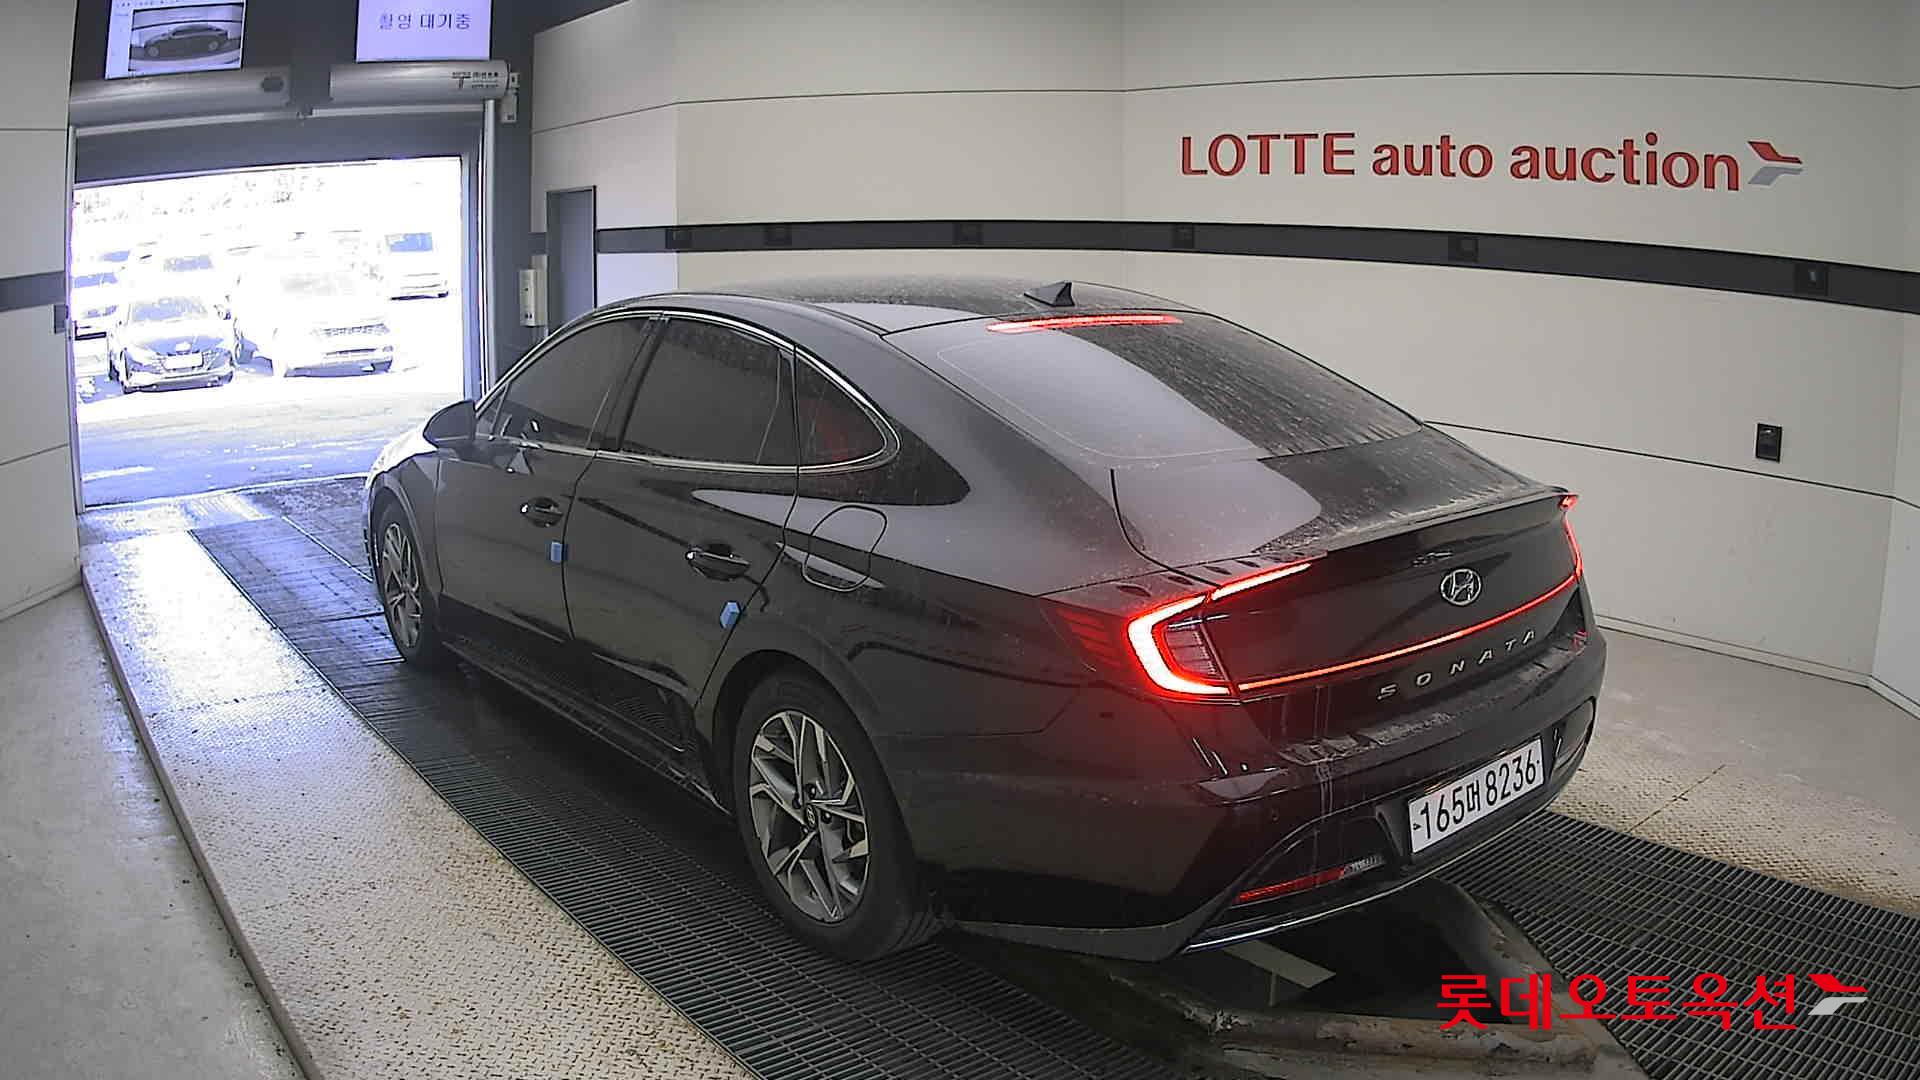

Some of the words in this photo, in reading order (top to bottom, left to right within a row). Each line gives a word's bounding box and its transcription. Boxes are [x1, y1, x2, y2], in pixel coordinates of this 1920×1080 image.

[420, 13, 471, 30] 대기중
[1181, 132, 1355, 176] LOTTE
[1372, 134, 1493, 178] auto
[1509, 131, 1740, 191] auction
[1377, 629, 1537, 701] SONATA
